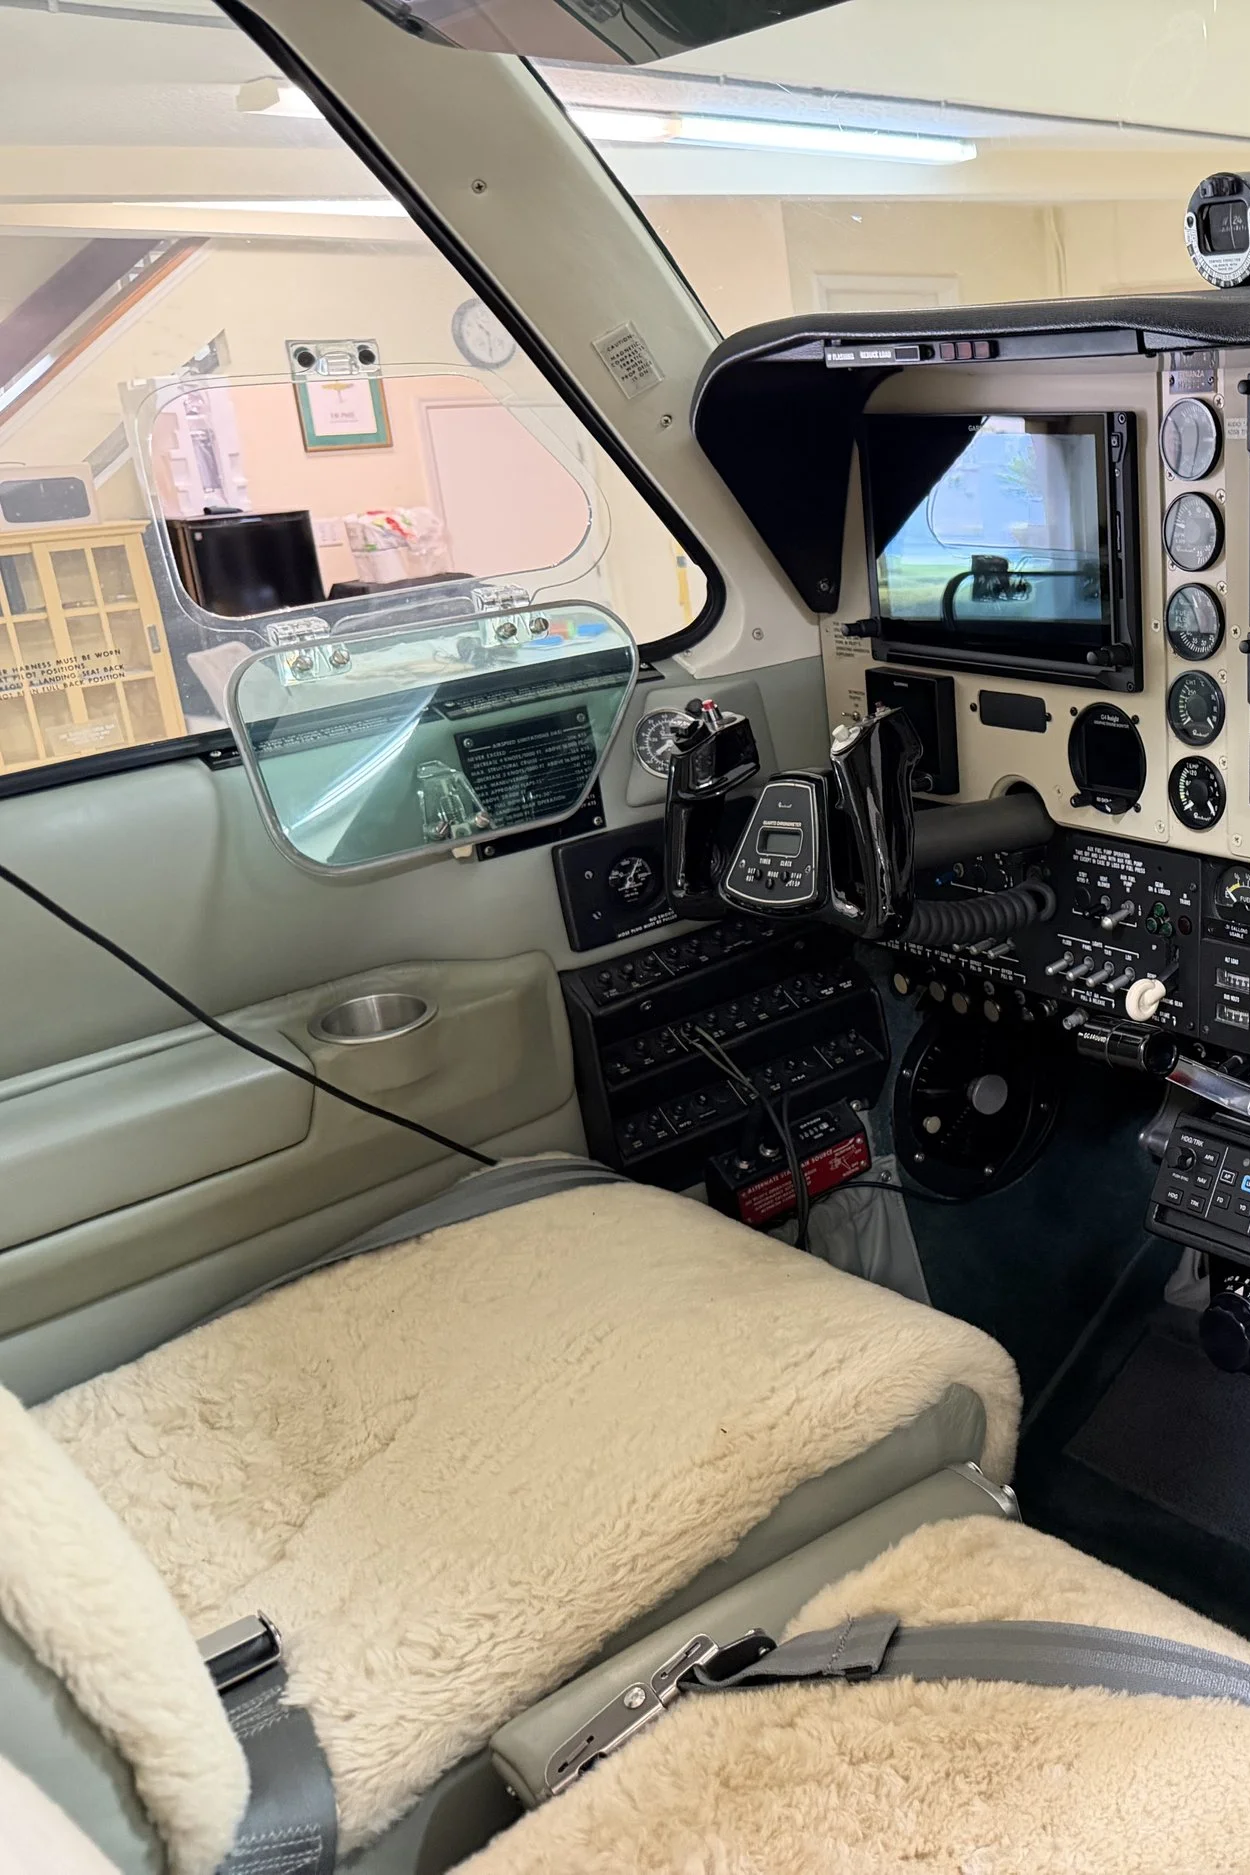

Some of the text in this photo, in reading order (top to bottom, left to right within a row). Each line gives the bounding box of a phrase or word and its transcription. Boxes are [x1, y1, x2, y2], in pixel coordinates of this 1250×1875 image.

[12, 661, 51, 674] HARNESS
[56, 657, 77, 665] MUST
[95, 649, 121, 659] WORN
[39, 673, 76, 685] LANDING
[104, 664, 124, 673] BACK
[41, 663, 85, 676] POSITIONS
[88, 672, 125, 683] POSITION
[1231, 925, 1248, 934] GALLONS
[1181, 1135, 1204, 1147] HDG/TRK
[748, 1175, 779, 1194] ALTERNATE
[811, 1149, 833, 1163] SOURCE
